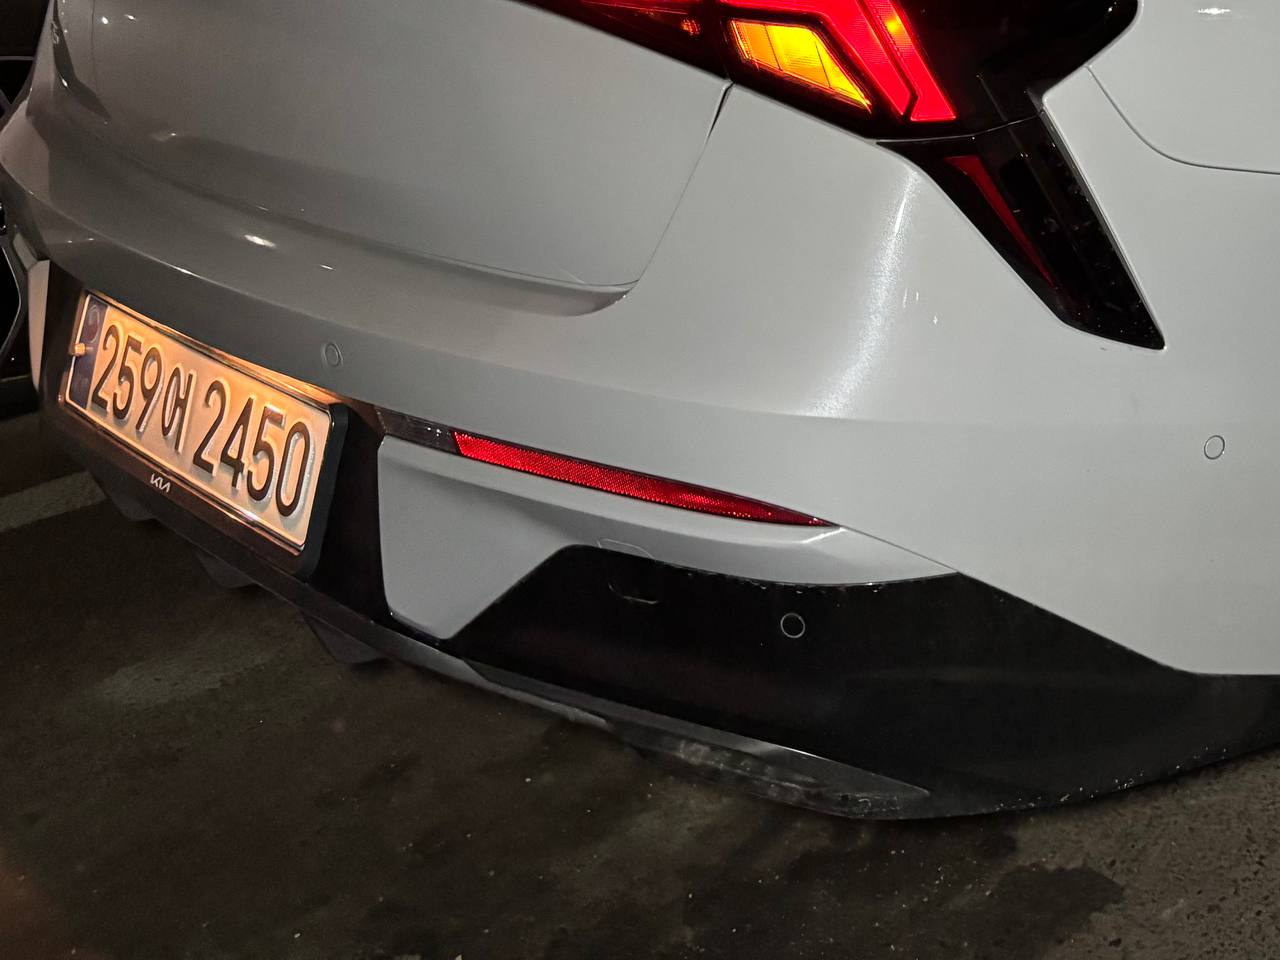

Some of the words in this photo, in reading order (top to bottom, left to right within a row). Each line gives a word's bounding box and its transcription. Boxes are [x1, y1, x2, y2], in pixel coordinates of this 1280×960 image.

[93, 323, 194, 454] 259어
[193, 379, 311, 518] 2450
[150, 473, 171, 493] KIA
